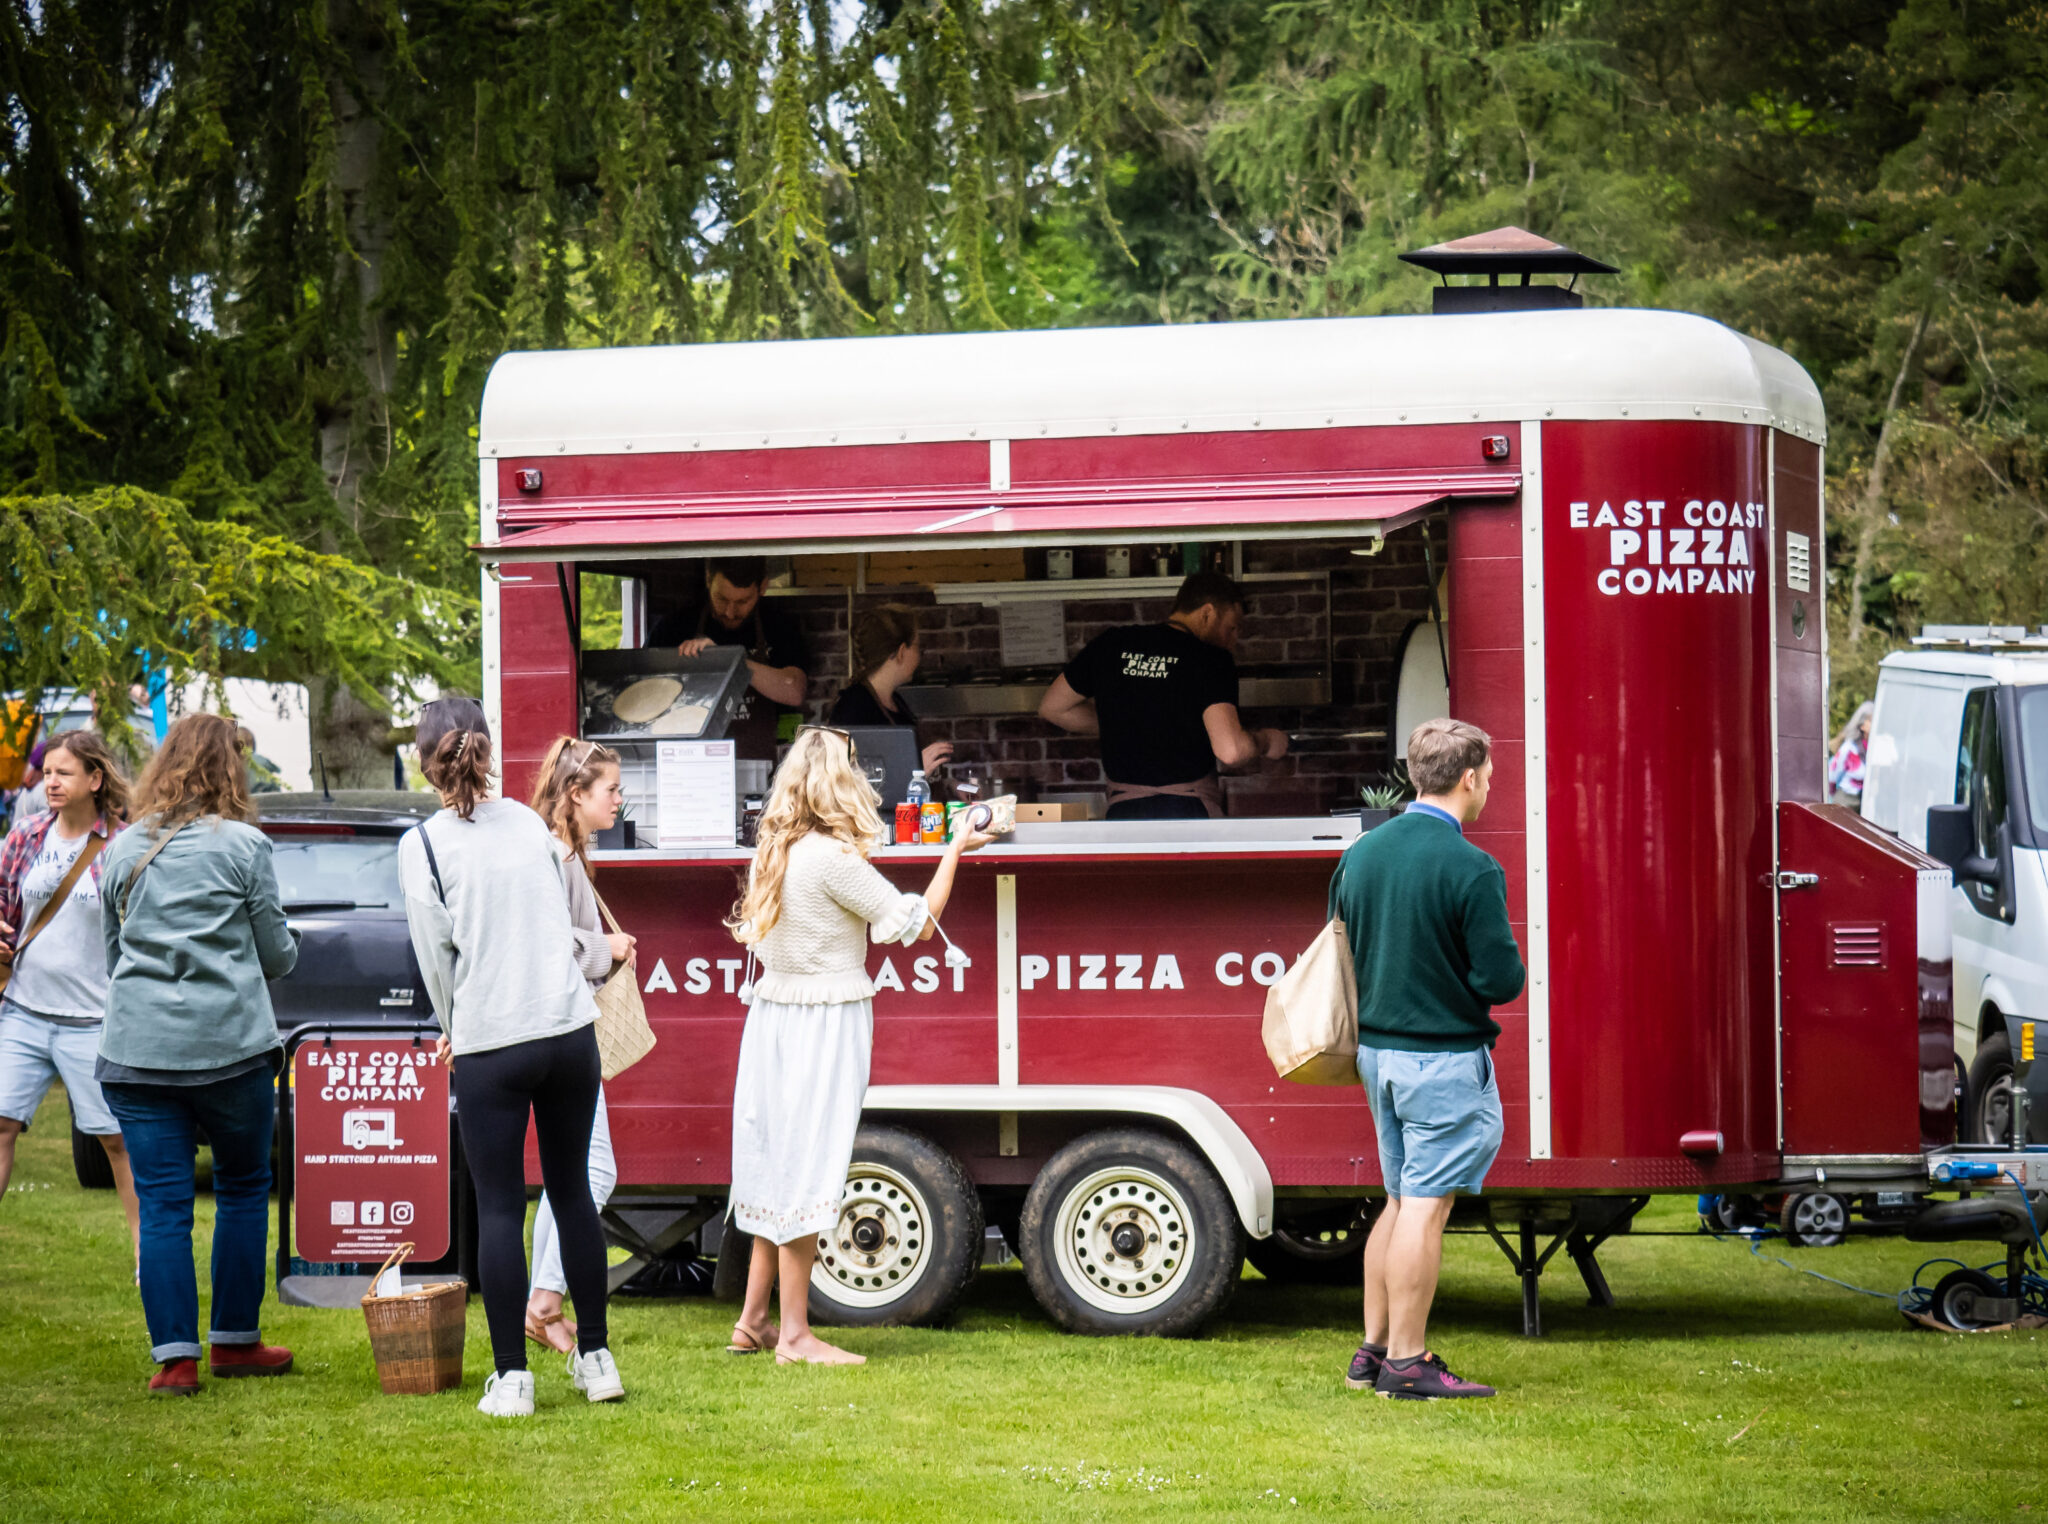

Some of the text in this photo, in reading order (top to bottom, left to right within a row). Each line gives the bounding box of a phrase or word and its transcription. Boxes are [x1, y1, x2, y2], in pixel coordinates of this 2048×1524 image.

[1569, 499, 1764, 529] EAST COAST
[1609, 528, 1750, 566] PIZZA
[1597, 567, 1756, 596] COMPANY
[1121, 652, 1179, 664] EAST COAST
[1127, 659, 1166, 672] PIZZA
[1122, 667, 1169, 679] COMPANY
[24, 888, 53, 900] SAILIN
[644, 957, 742, 994] AST
[873, 956, 971, 993] AST
[1020, 954, 1185, 990] PIZZA
[307, 1051, 438, 1067] EAST COAST
[327, 1066, 419, 1086] PIZZA
[320, 1086, 425, 1102] COMPANY
[304, 1155, 438, 1164] HAND STRETCHED ARTISAN PIZZA
